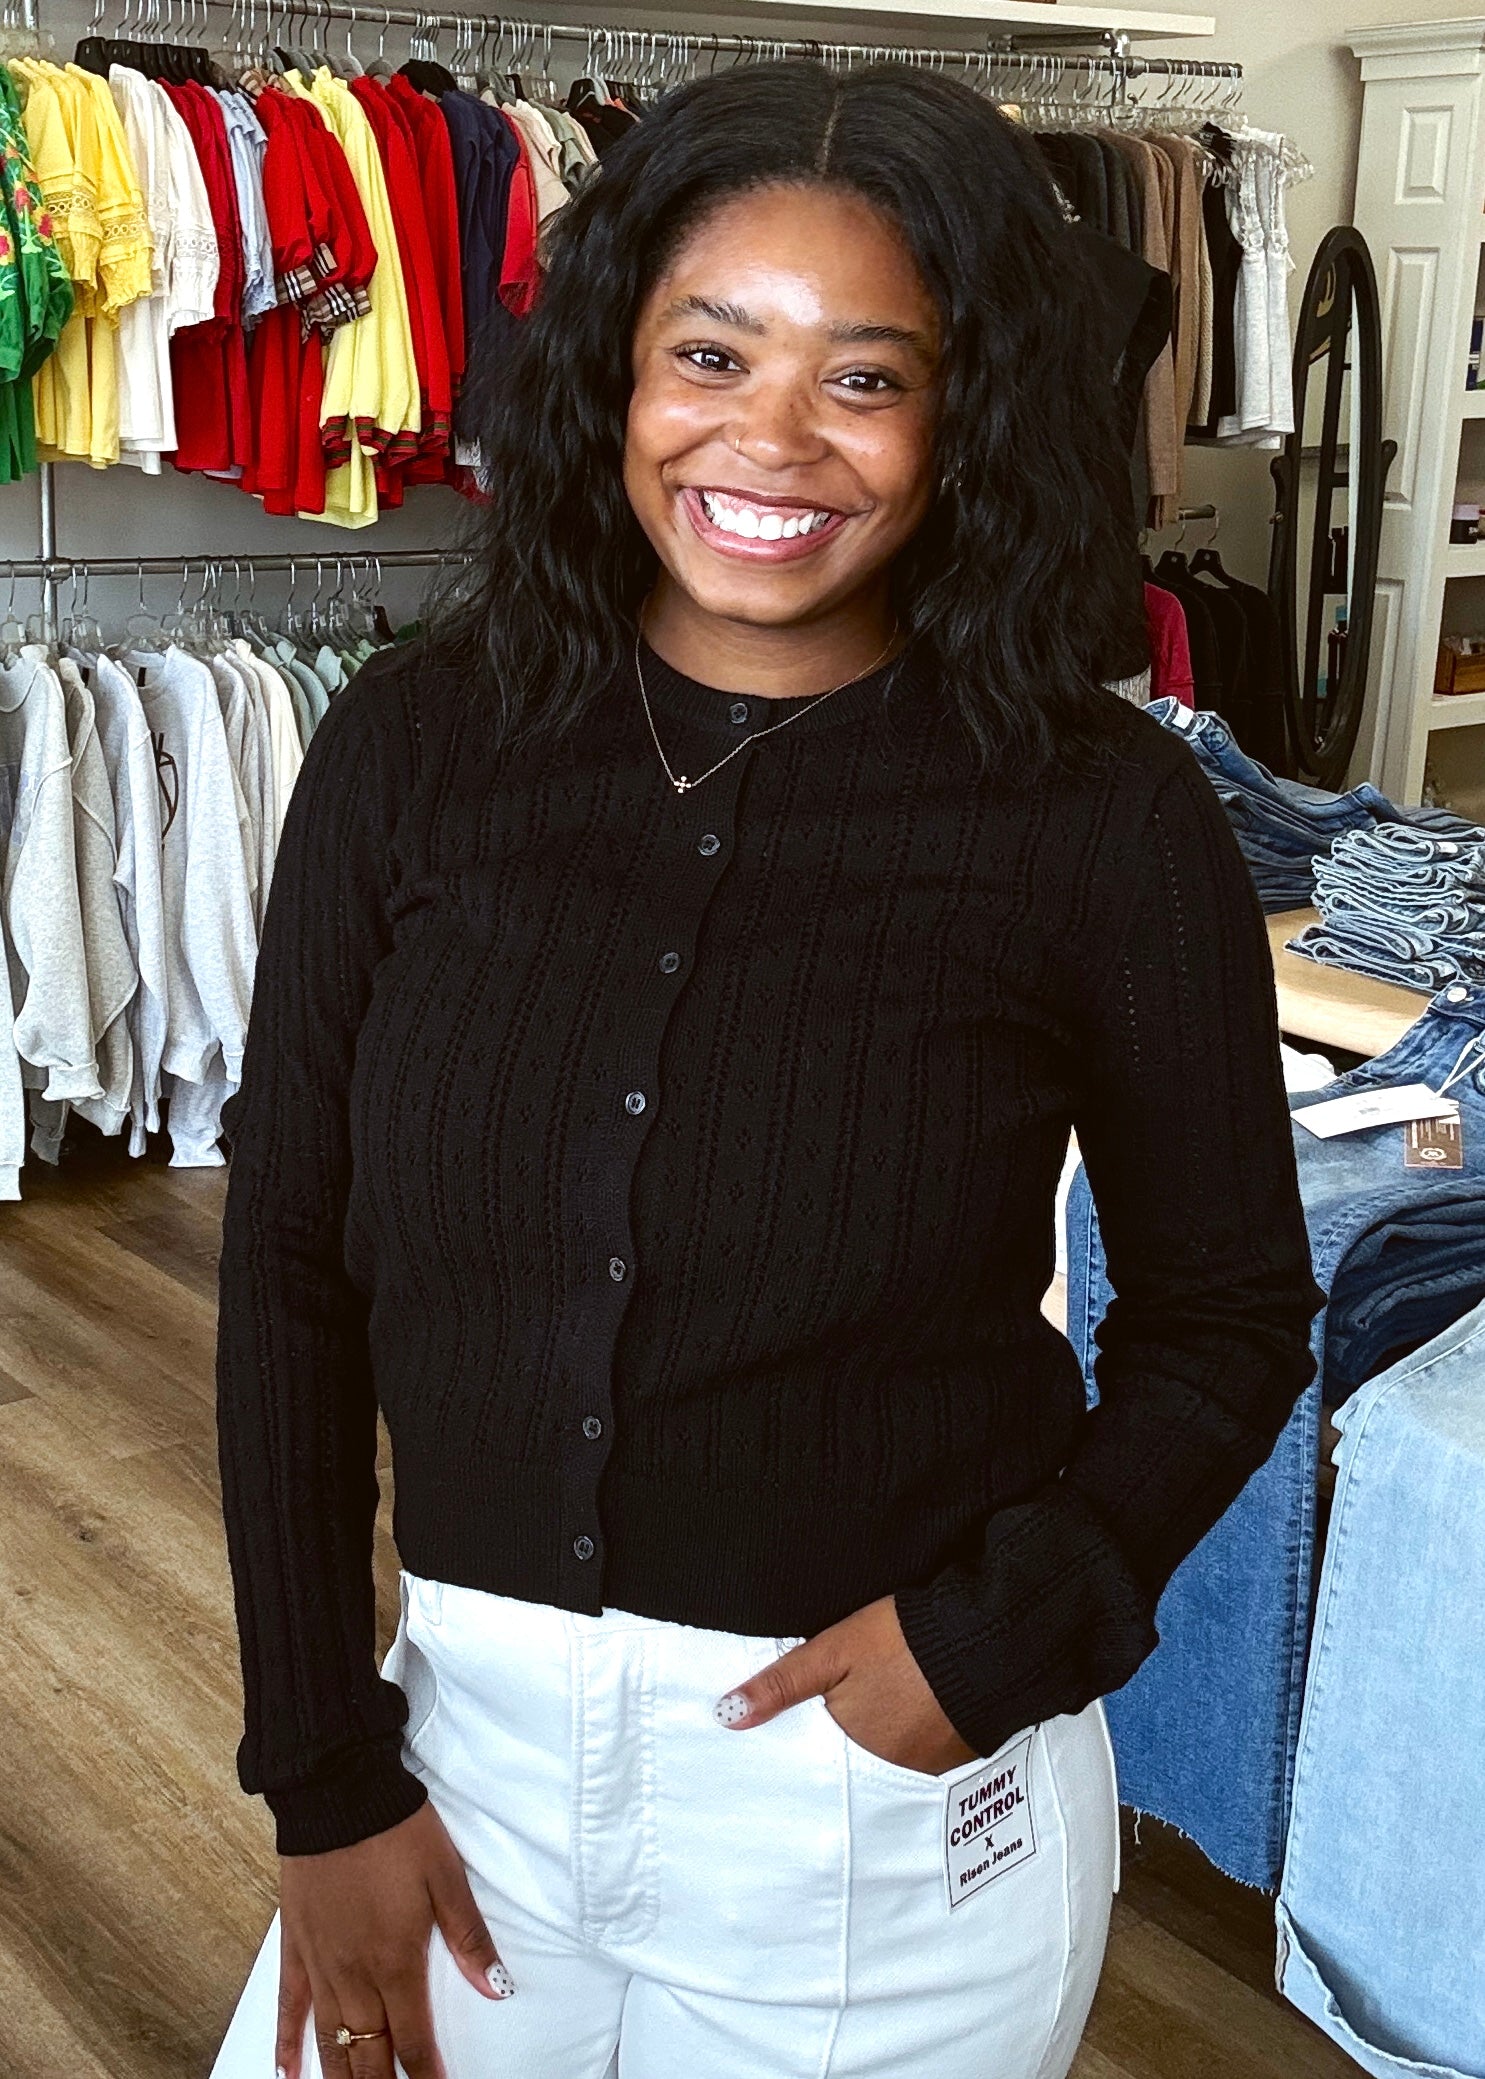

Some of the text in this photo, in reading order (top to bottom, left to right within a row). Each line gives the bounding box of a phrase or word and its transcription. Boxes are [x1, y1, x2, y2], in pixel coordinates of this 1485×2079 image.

[950, 1786, 1024, 1847] CONTROL
[959, 1765, 1017, 1817] TUMMY
[992, 1837, 1023, 1865] Jeans
